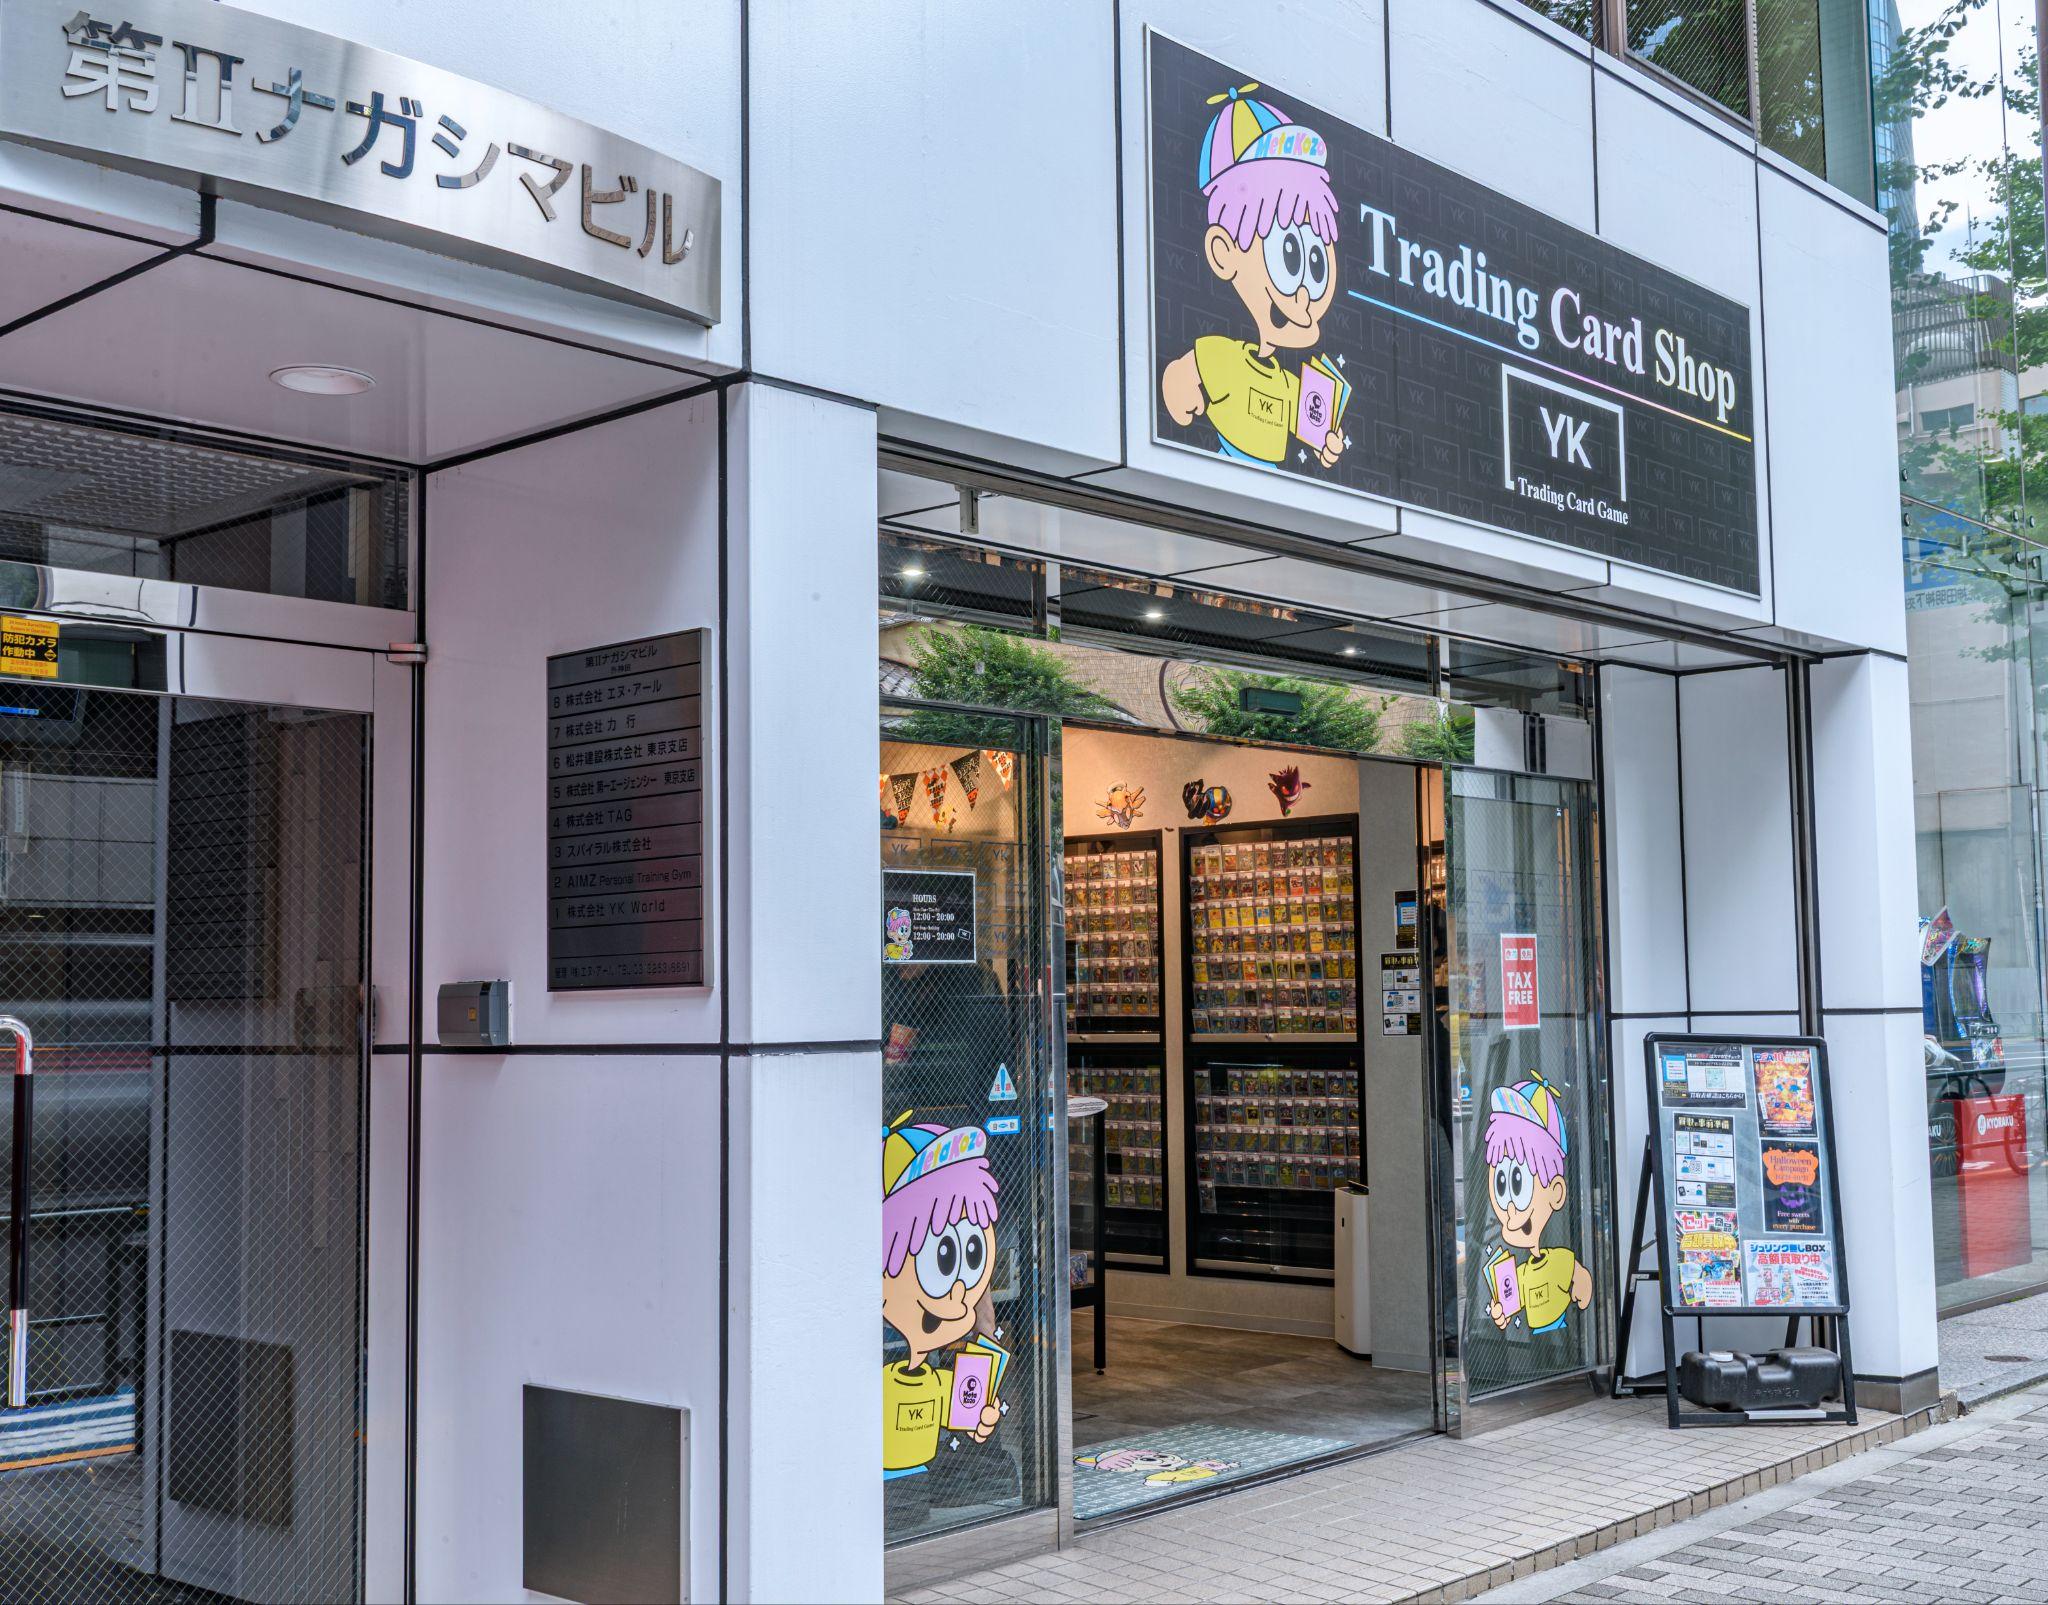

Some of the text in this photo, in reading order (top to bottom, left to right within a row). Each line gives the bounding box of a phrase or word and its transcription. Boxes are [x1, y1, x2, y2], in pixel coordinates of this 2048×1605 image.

[1255, 131, 1327, 159] MetaKozo
[1360, 203, 1736, 423] Trading Card Shop
[1259, 398, 1273, 414] YK
[1540, 406, 1592, 469] YK
[1518, 476, 1629, 525] Trading Card Game
[2, 632, 57, 648] 防犯カメラ
[2, 645, 36, 658] 作動中
[566, 690, 603, 707] 株式会社
[554, 727, 560, 739] 7
[566, 720, 603, 737] 株式会社
[554, 738, 688, 769] 6 松井建設株式会社 東京支店
[554, 787, 560, 799] 5
[567, 783, 594, 797] 株式会社
[664, 768, 695, 785] 東京支店
[553, 809, 633, 829] 4 株式会社 TAG
[554, 837, 651, 858] 3 スパイラル株式会社
[554, 868, 692, 888] 2 AIMZ Personal Training Gym
[912, 894, 937, 903] HOURS
[568, 905, 605, 919] 株式会社
[609, 901, 625, 914] YK
[631, 898, 665, 913] World
[913, 913, 931, 921] 12:00
[936, 913, 955, 921] 20:00
[913, 932, 931, 940] 12:00
[936, 932, 955, 940] 20:00
[1507, 971, 1533, 989] TAX
[1508, 990, 1533, 1005] FREE
[1986, 1115, 2014, 1129] KYORAKU
[906, 1130, 985, 1182] MetaKozo
[1769, 1155, 1812, 1166] Halloween
[1773, 1164, 1809, 1173] Campaign
[1757, 1253, 1820, 1264] 高額買取り中
[1535, 1290, 1543, 1300] YK
[963, 1390, 977, 1398] Meta
[909, 1408, 923, 1420] YK
